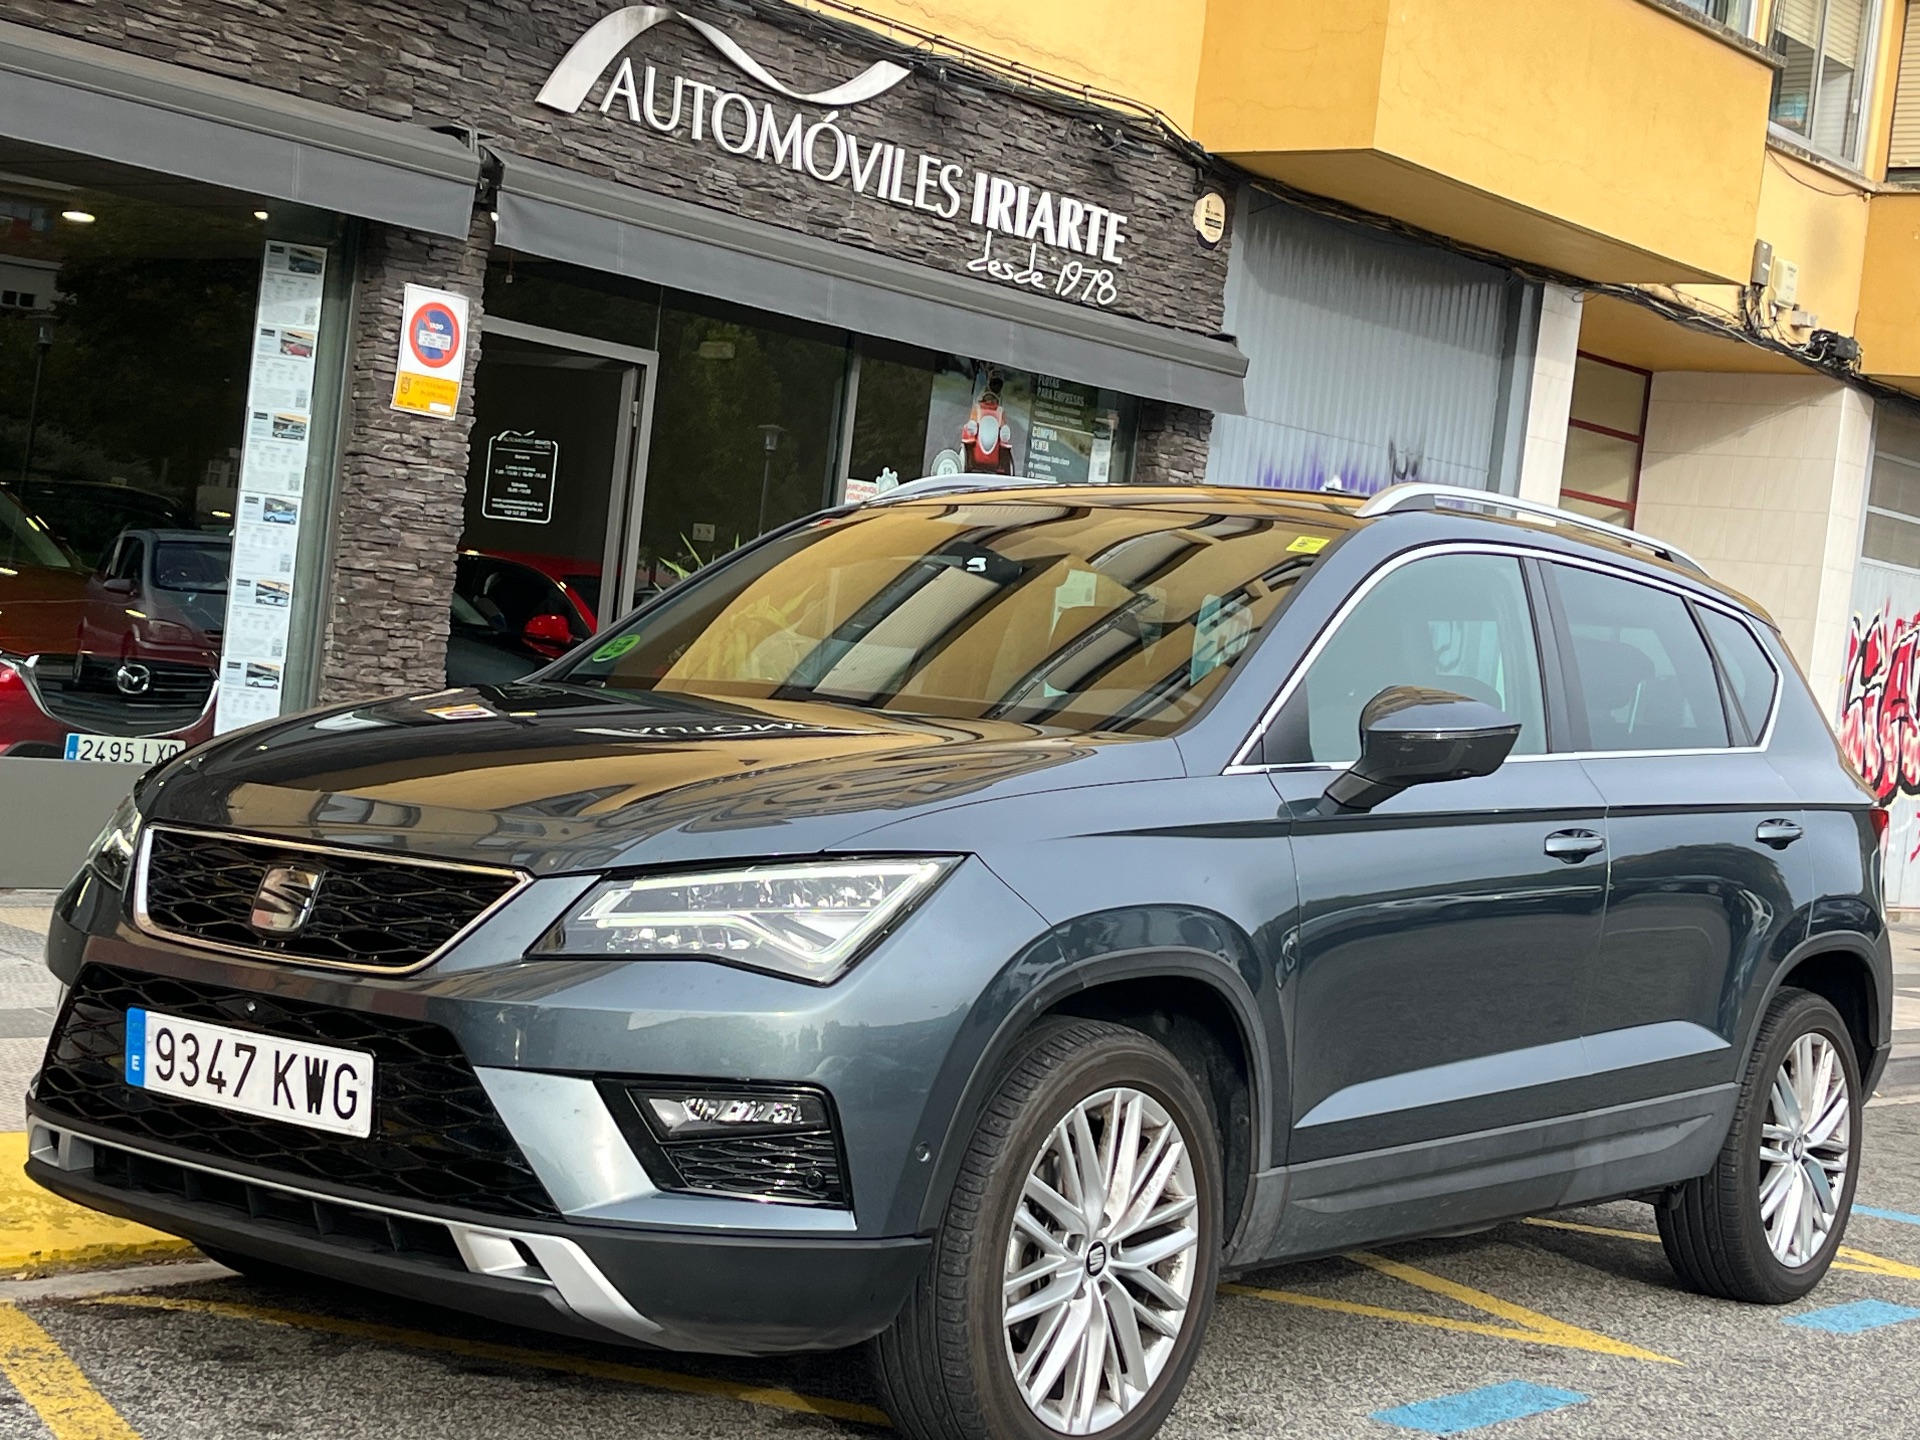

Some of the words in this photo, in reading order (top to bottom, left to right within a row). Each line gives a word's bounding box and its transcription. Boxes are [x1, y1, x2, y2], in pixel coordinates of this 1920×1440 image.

[599, 57, 963, 218] AUTOMÓVILES
[971, 172, 1128, 264] IRIARTE
[966, 230, 1046, 289] desde
[1055, 261, 1117, 305] 1978
[1036, 386, 1053, 399] PARA
[80, 739, 134, 763] 2495
[131, 1055, 141, 1072] E
[155, 1027, 257, 1098] 9347
[273, 1049, 359, 1120] KWG
